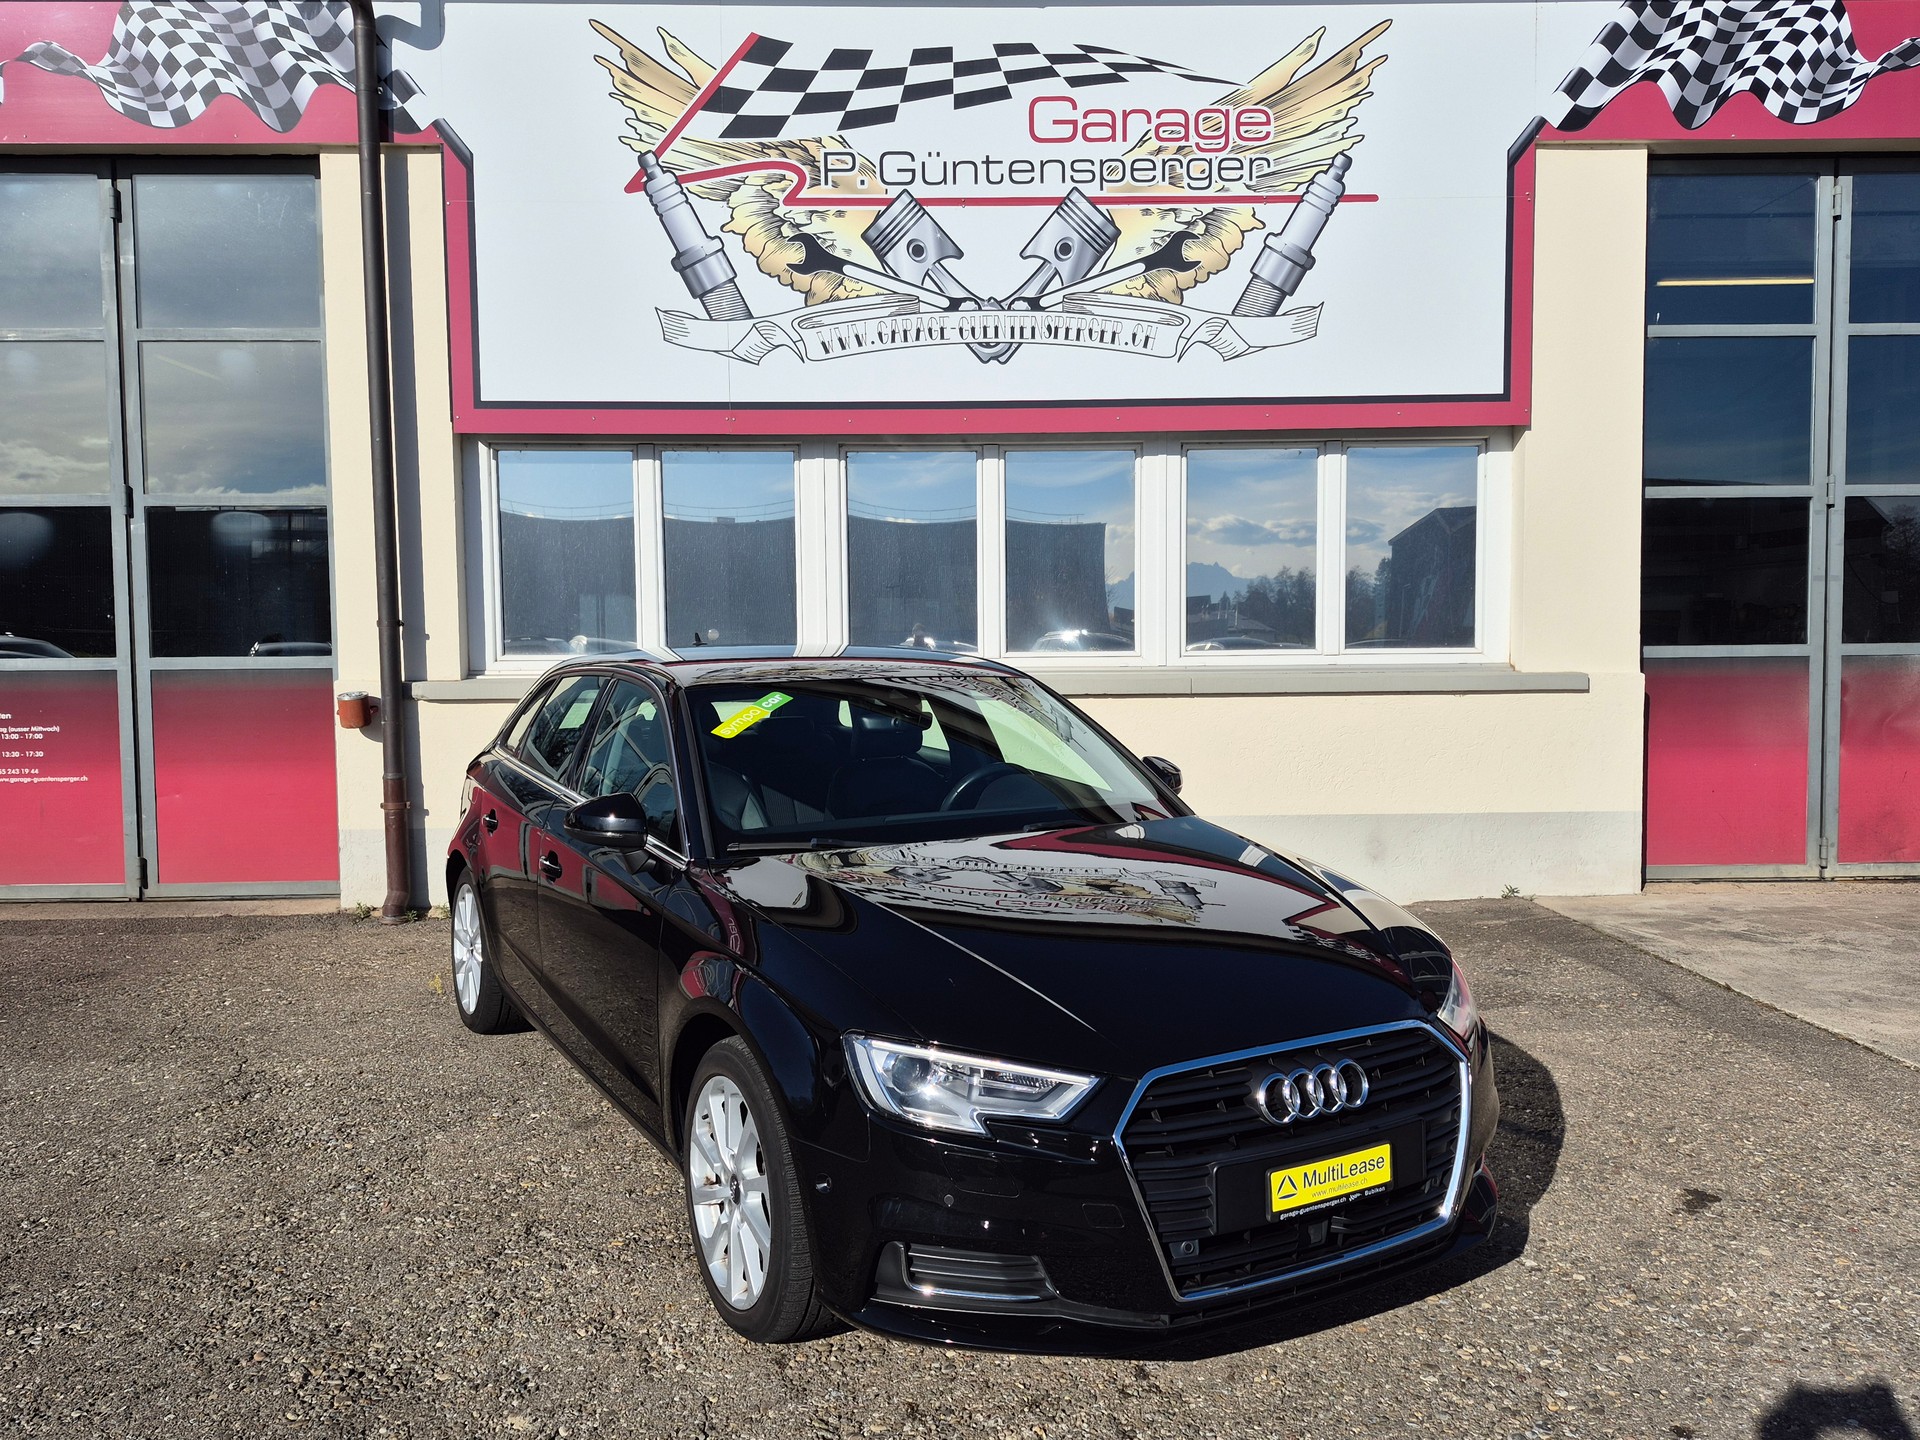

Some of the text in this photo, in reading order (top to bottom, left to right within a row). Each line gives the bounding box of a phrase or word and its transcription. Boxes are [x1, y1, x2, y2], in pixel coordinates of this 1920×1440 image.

[1028, 96, 1273, 153] Garage
[1303, 1156, 1385, 1189] MultiLease
[1311, 1177, 1368, 1199] www.multilease.ch
